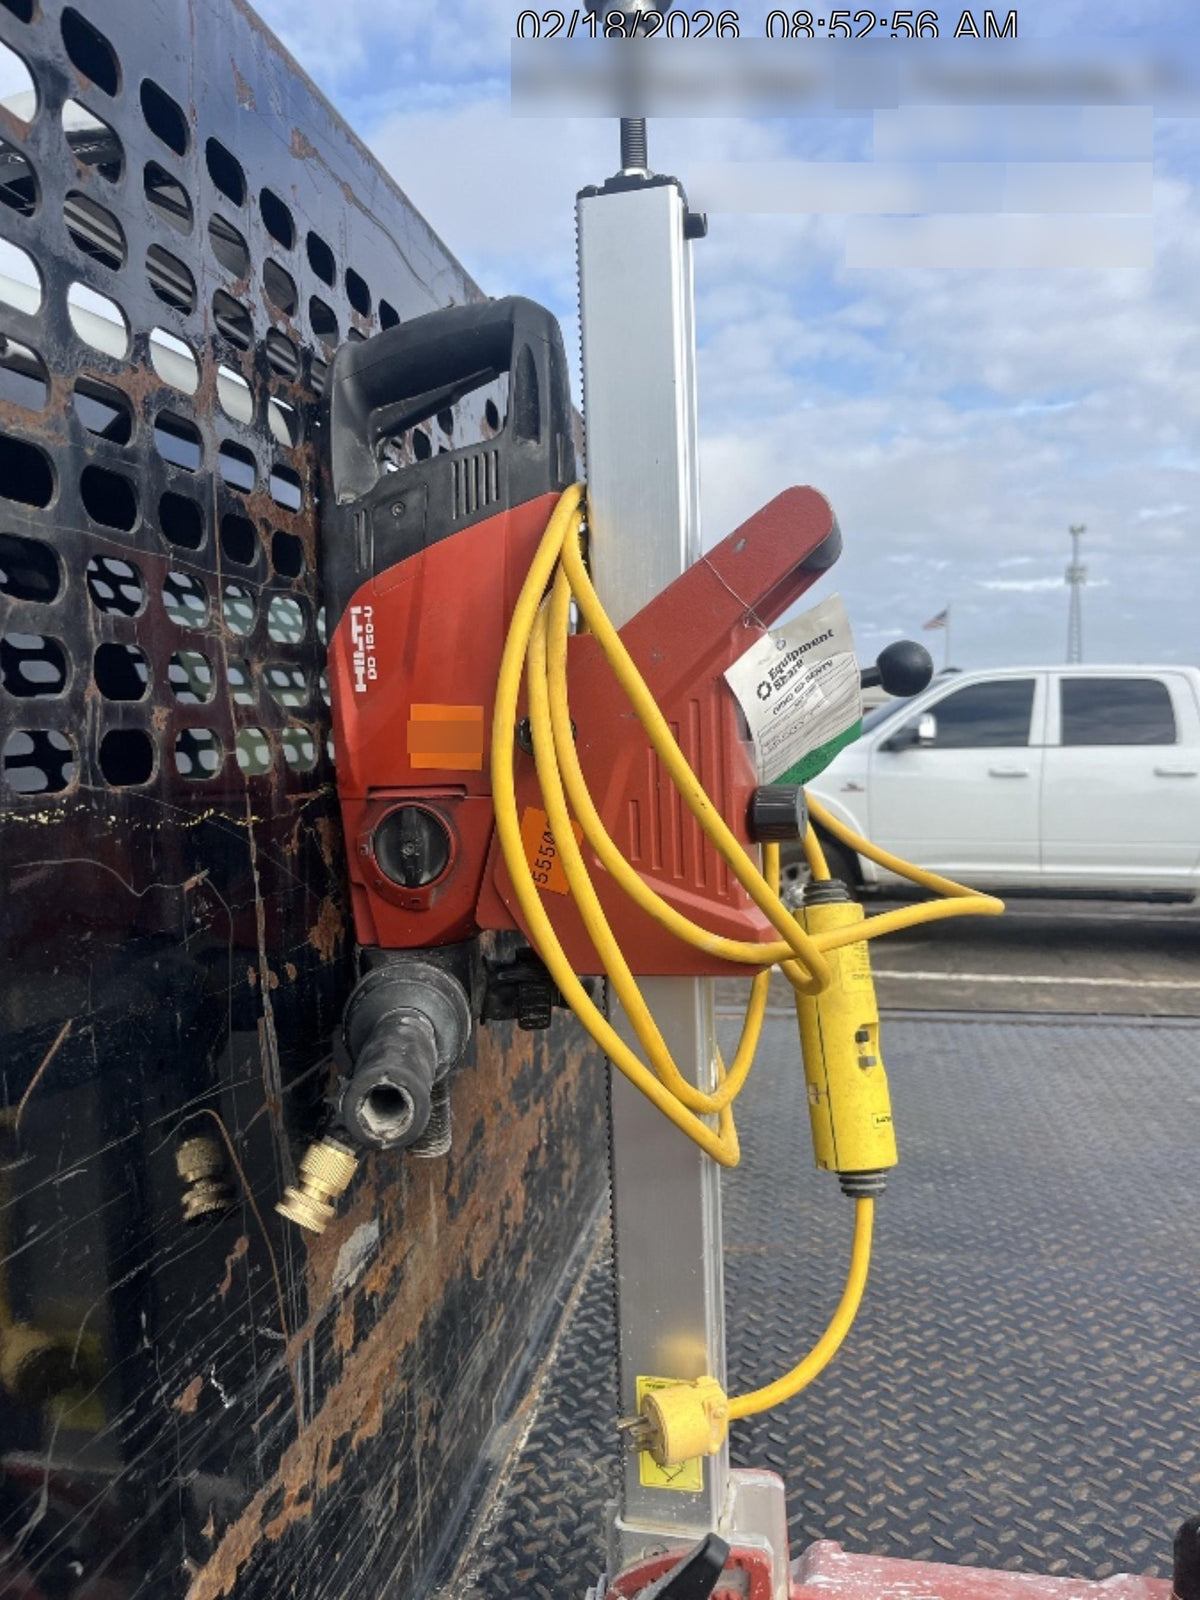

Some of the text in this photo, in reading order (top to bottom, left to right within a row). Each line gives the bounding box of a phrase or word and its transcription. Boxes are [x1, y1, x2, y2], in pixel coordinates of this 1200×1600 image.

[350, 606, 366, 692] HILTI
[364, 606, 377, 680] DD 150-U
[768, 628, 834, 681] Equipment
[773, 658, 803, 691] Share
